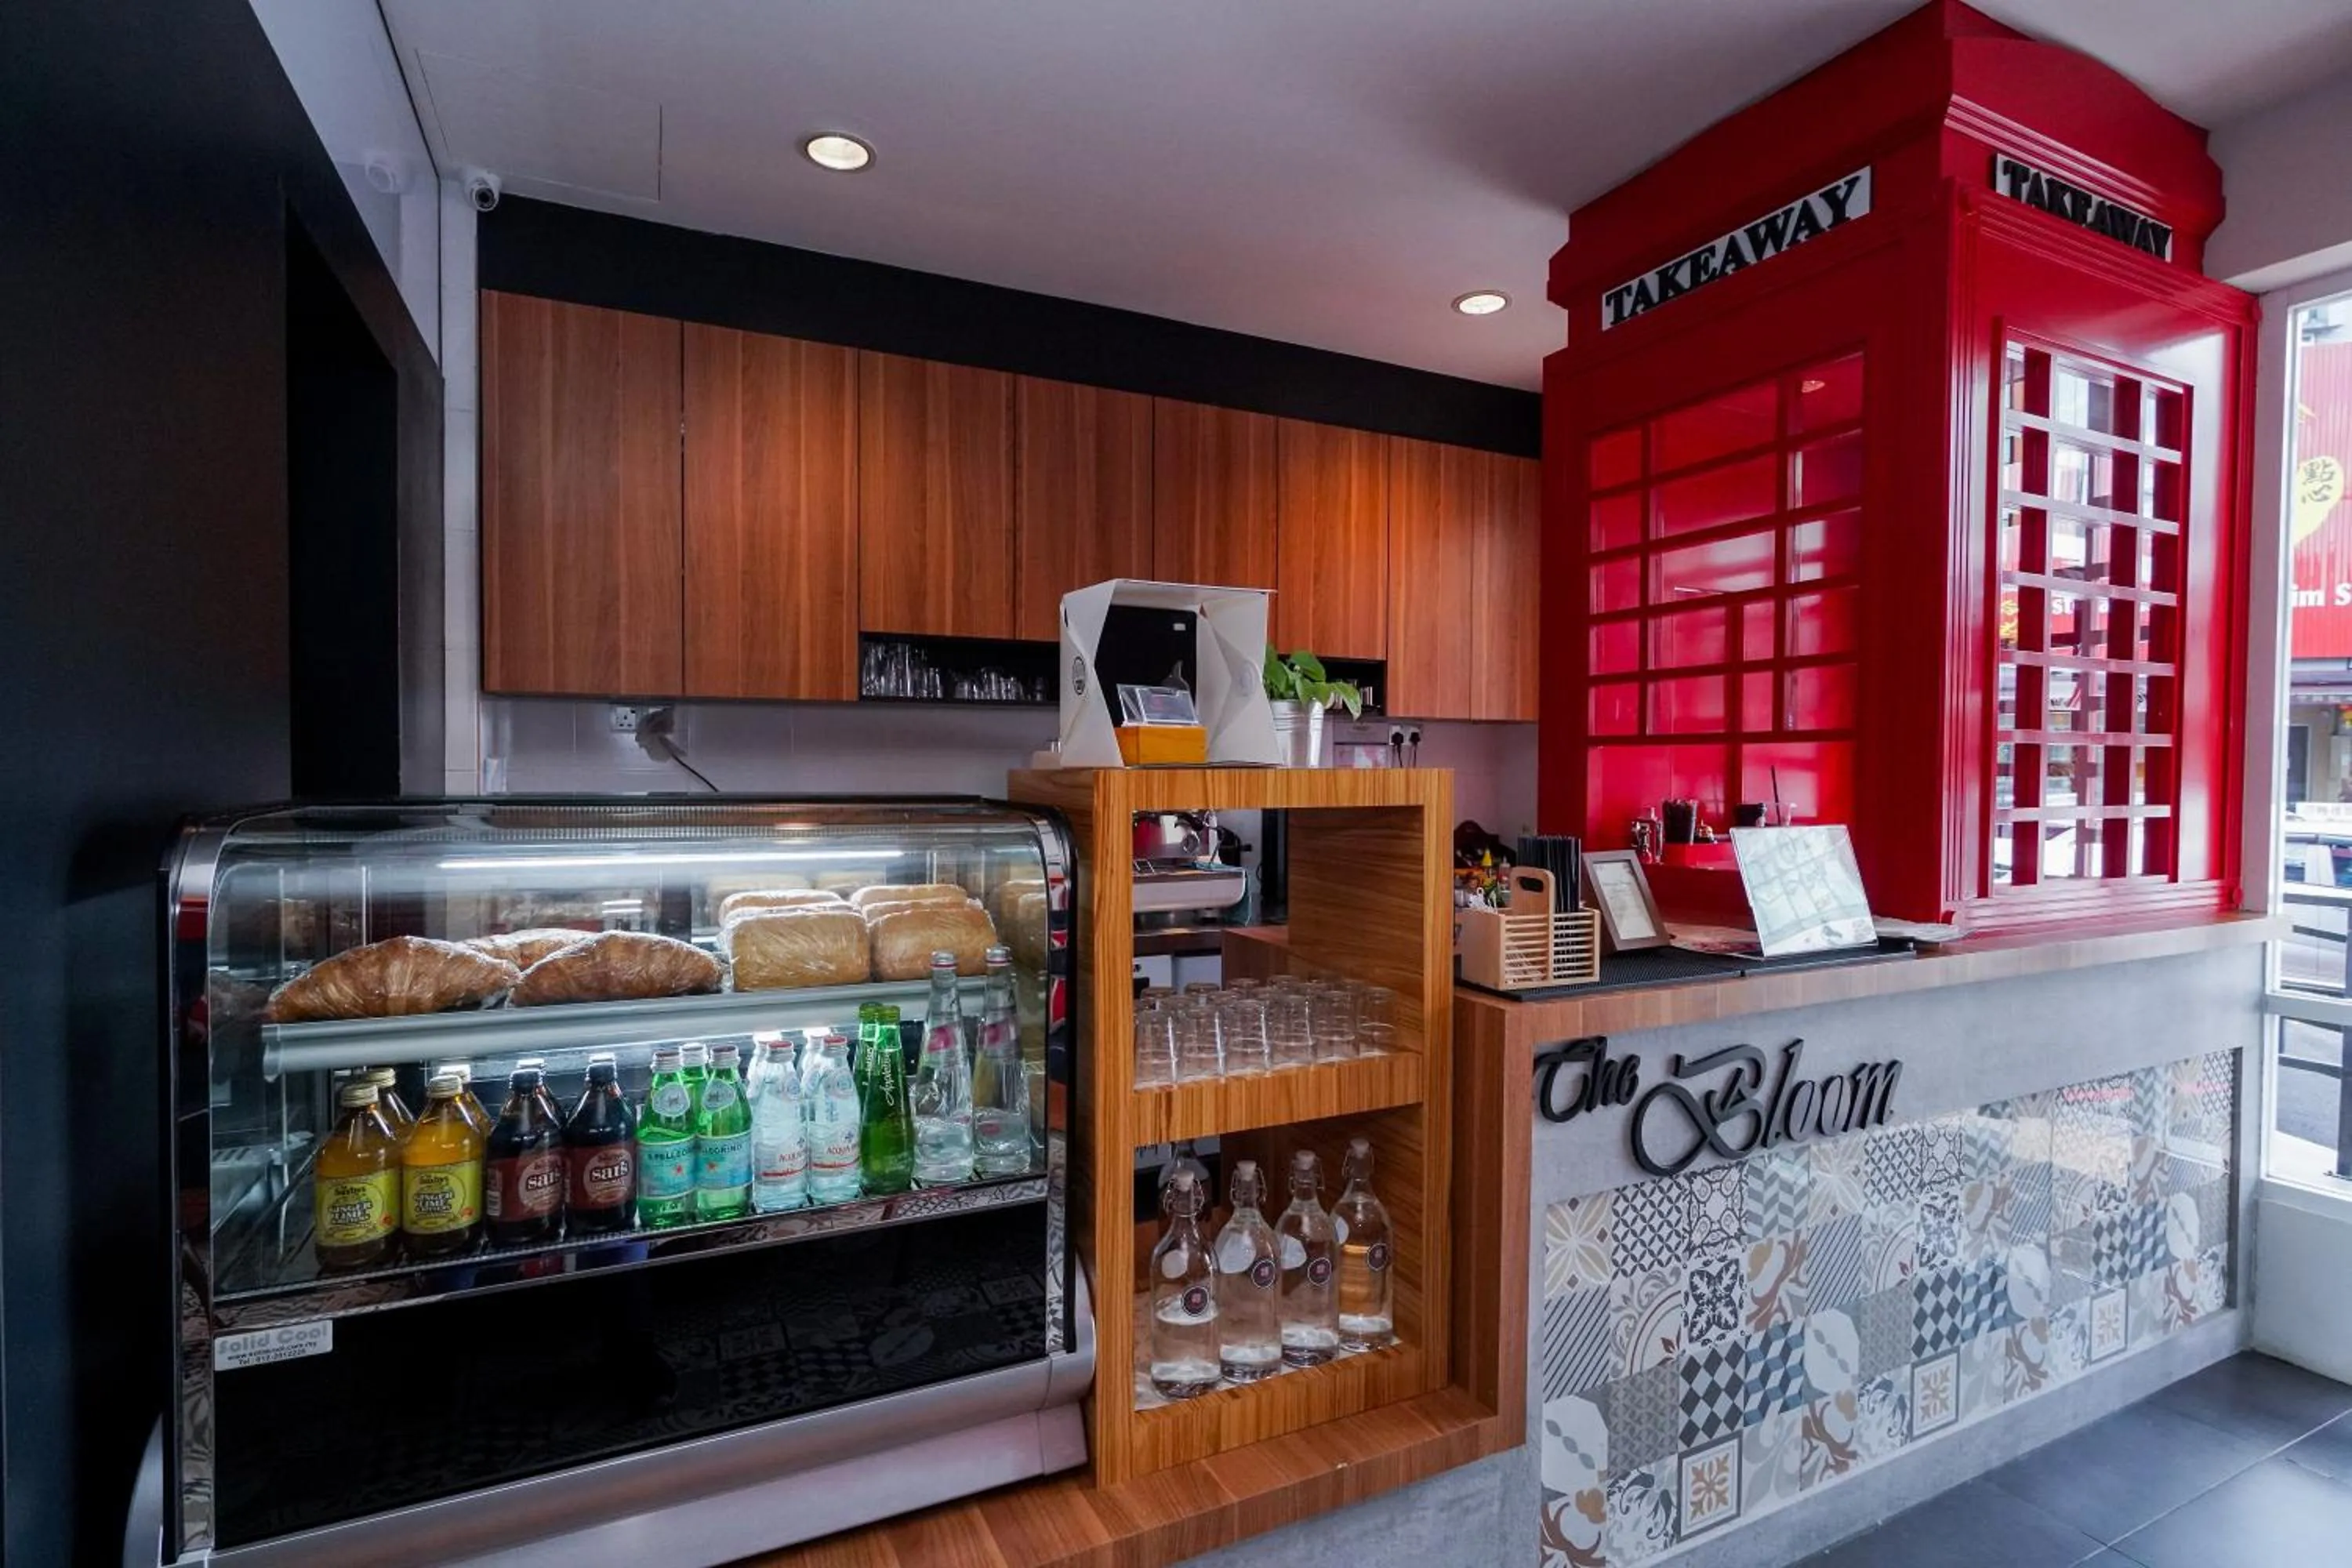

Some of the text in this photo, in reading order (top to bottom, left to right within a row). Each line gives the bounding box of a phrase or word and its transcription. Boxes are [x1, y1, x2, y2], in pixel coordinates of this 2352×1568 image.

[1605, 174, 1862, 325] TAKEAWAY
[2003, 158, 2172, 260] TAKEAWAY
[2291, 583, 2326, 608] im
[1532, 1034, 1904, 1177] The Bloom
[219, 1324, 328, 1355] Solid Cool
